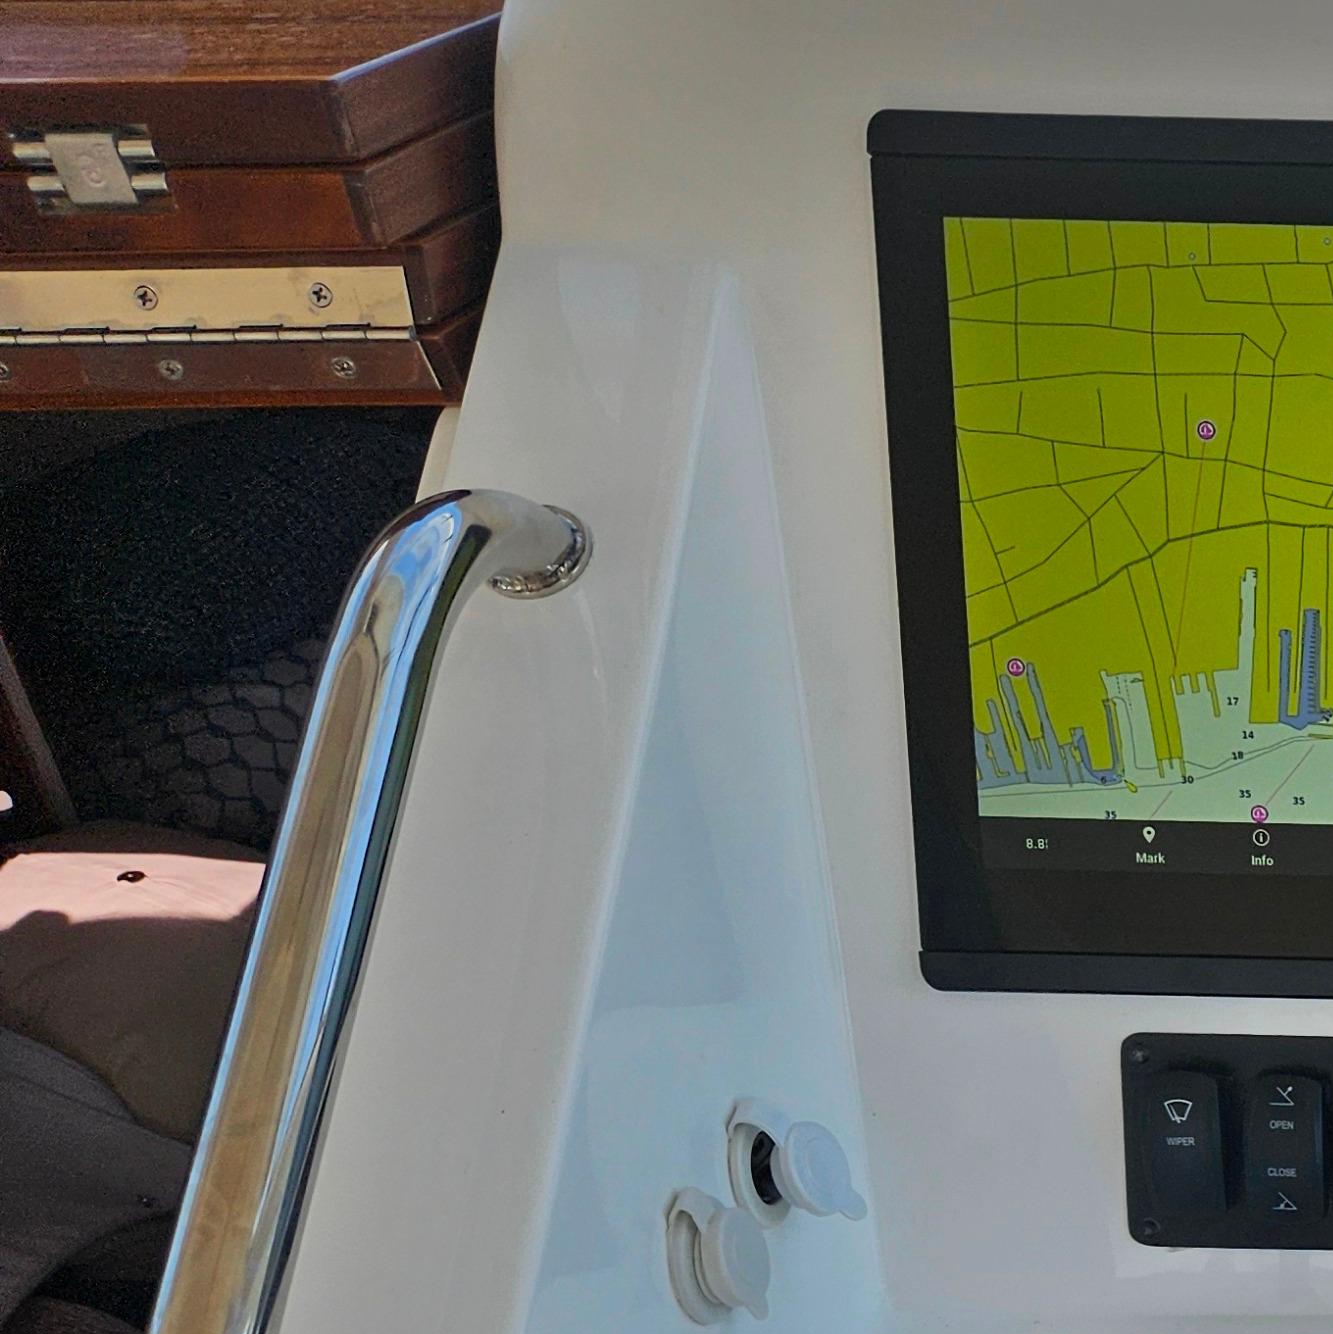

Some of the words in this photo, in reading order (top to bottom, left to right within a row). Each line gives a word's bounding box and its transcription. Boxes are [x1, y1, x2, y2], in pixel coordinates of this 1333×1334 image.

[1135, 851, 1166, 865] Mark
[1251, 854, 1274, 867] Info
[1269, 1120, 1294, 1130] OPEN
[1166, 1137, 1195, 1147] WIPER
[1267, 1167, 1297, 1178] CLOSE
